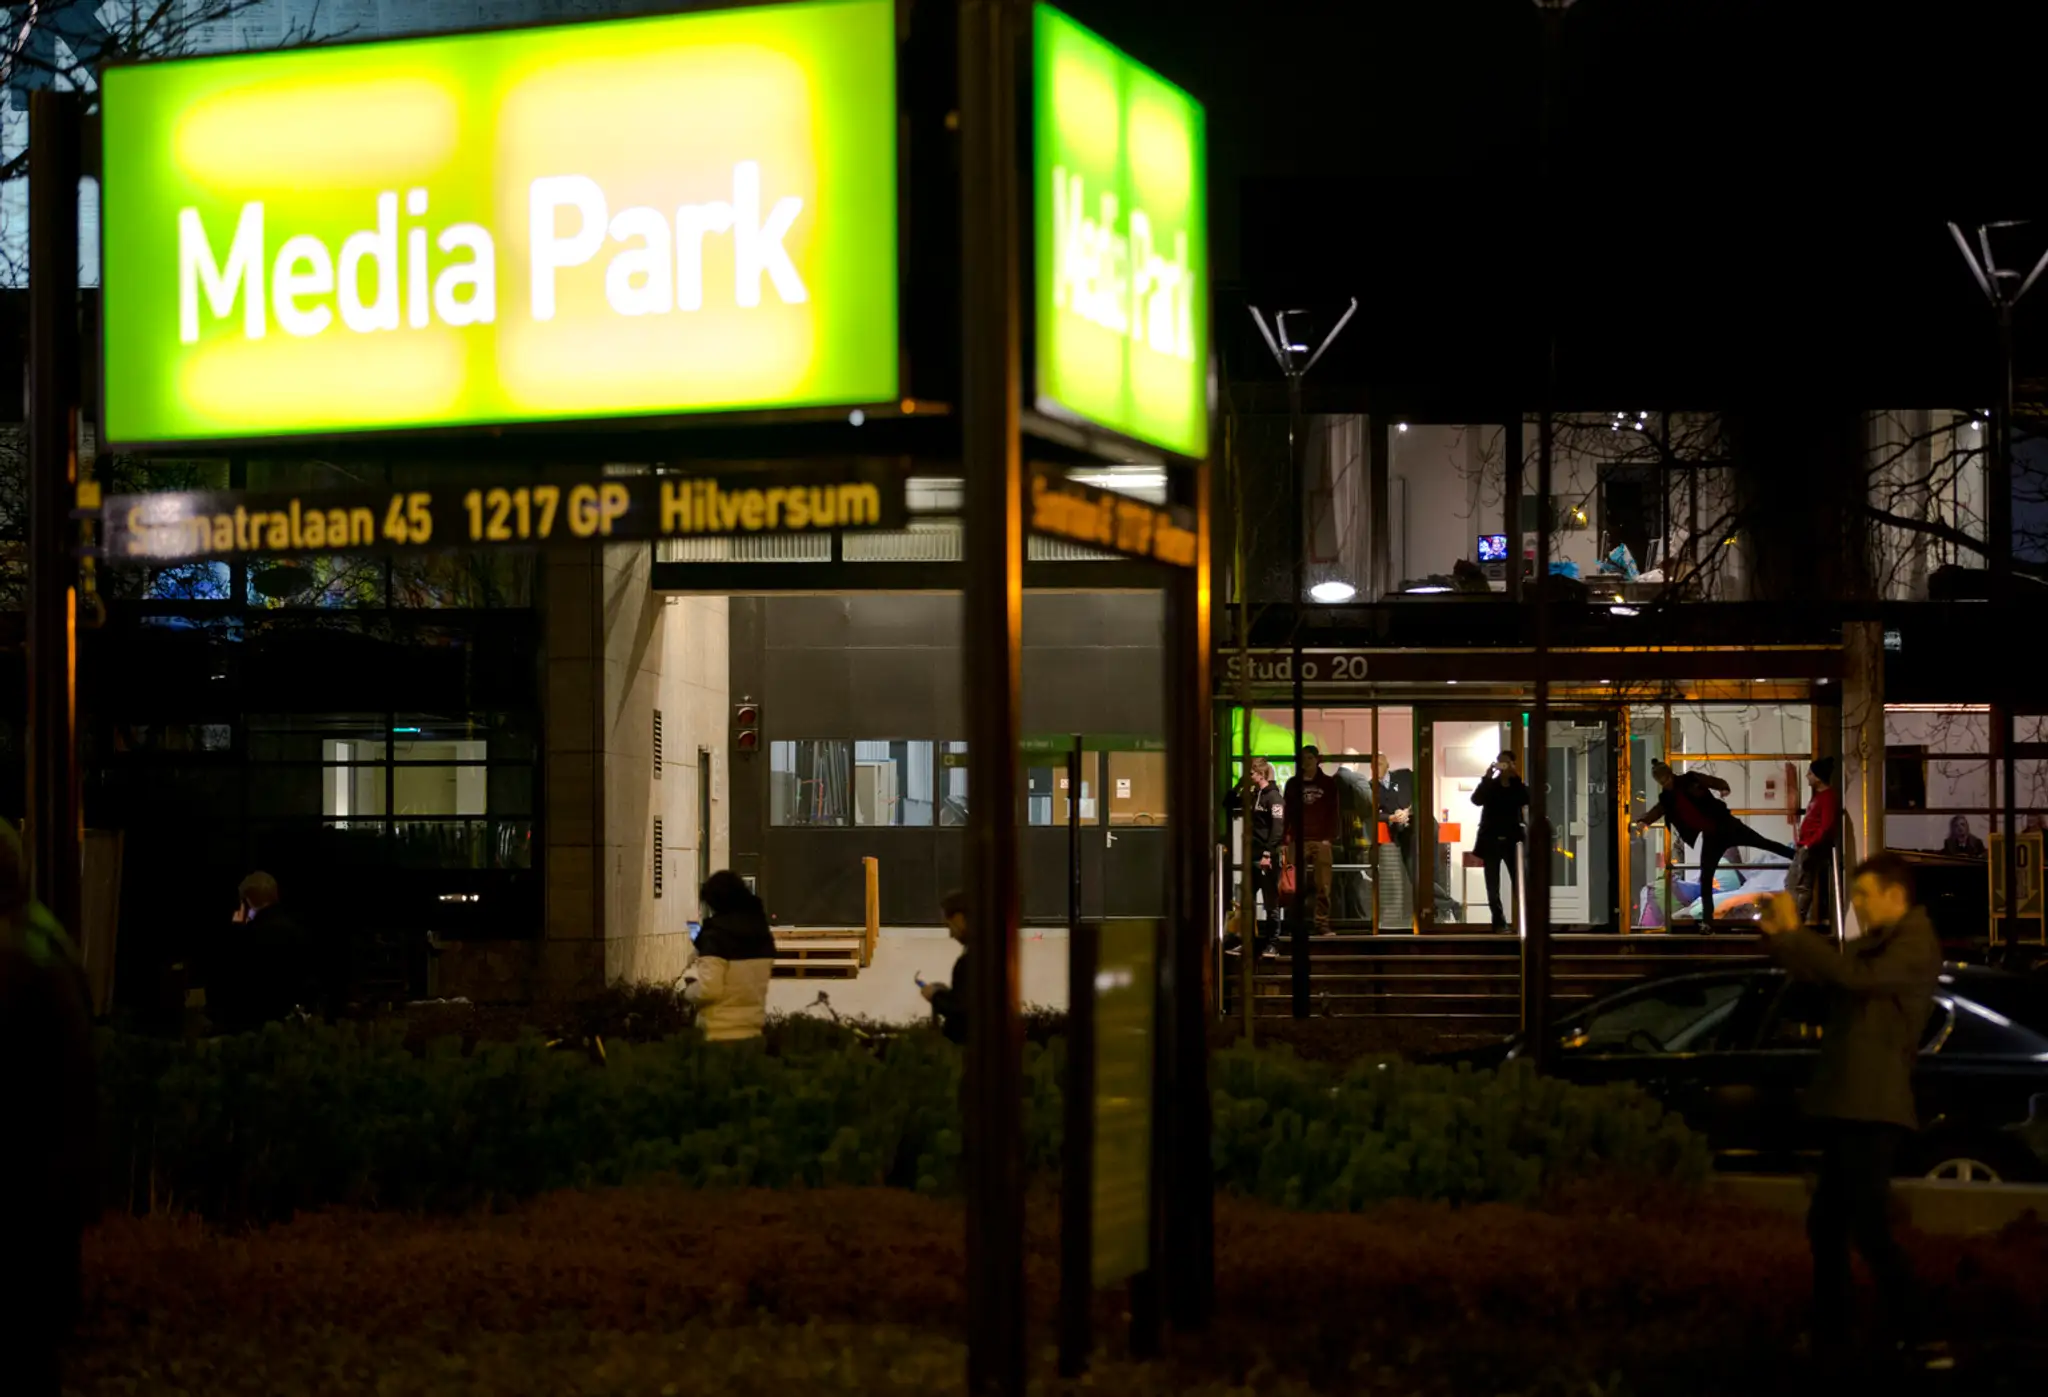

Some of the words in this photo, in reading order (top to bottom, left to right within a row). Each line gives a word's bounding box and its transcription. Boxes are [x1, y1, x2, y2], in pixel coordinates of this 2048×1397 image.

[180, 188, 496, 342] Media
[529, 159, 808, 321] Park
[126, 500, 375, 556] Smatralaan
[383, 491, 434, 544] 45
[464, 486, 560, 541] 1217
[567, 482, 629, 536] GP
[660, 477, 879, 532] Hilversum
[1227, 656, 1318, 680] Studo
[1331, 655, 1368, 680] 20
